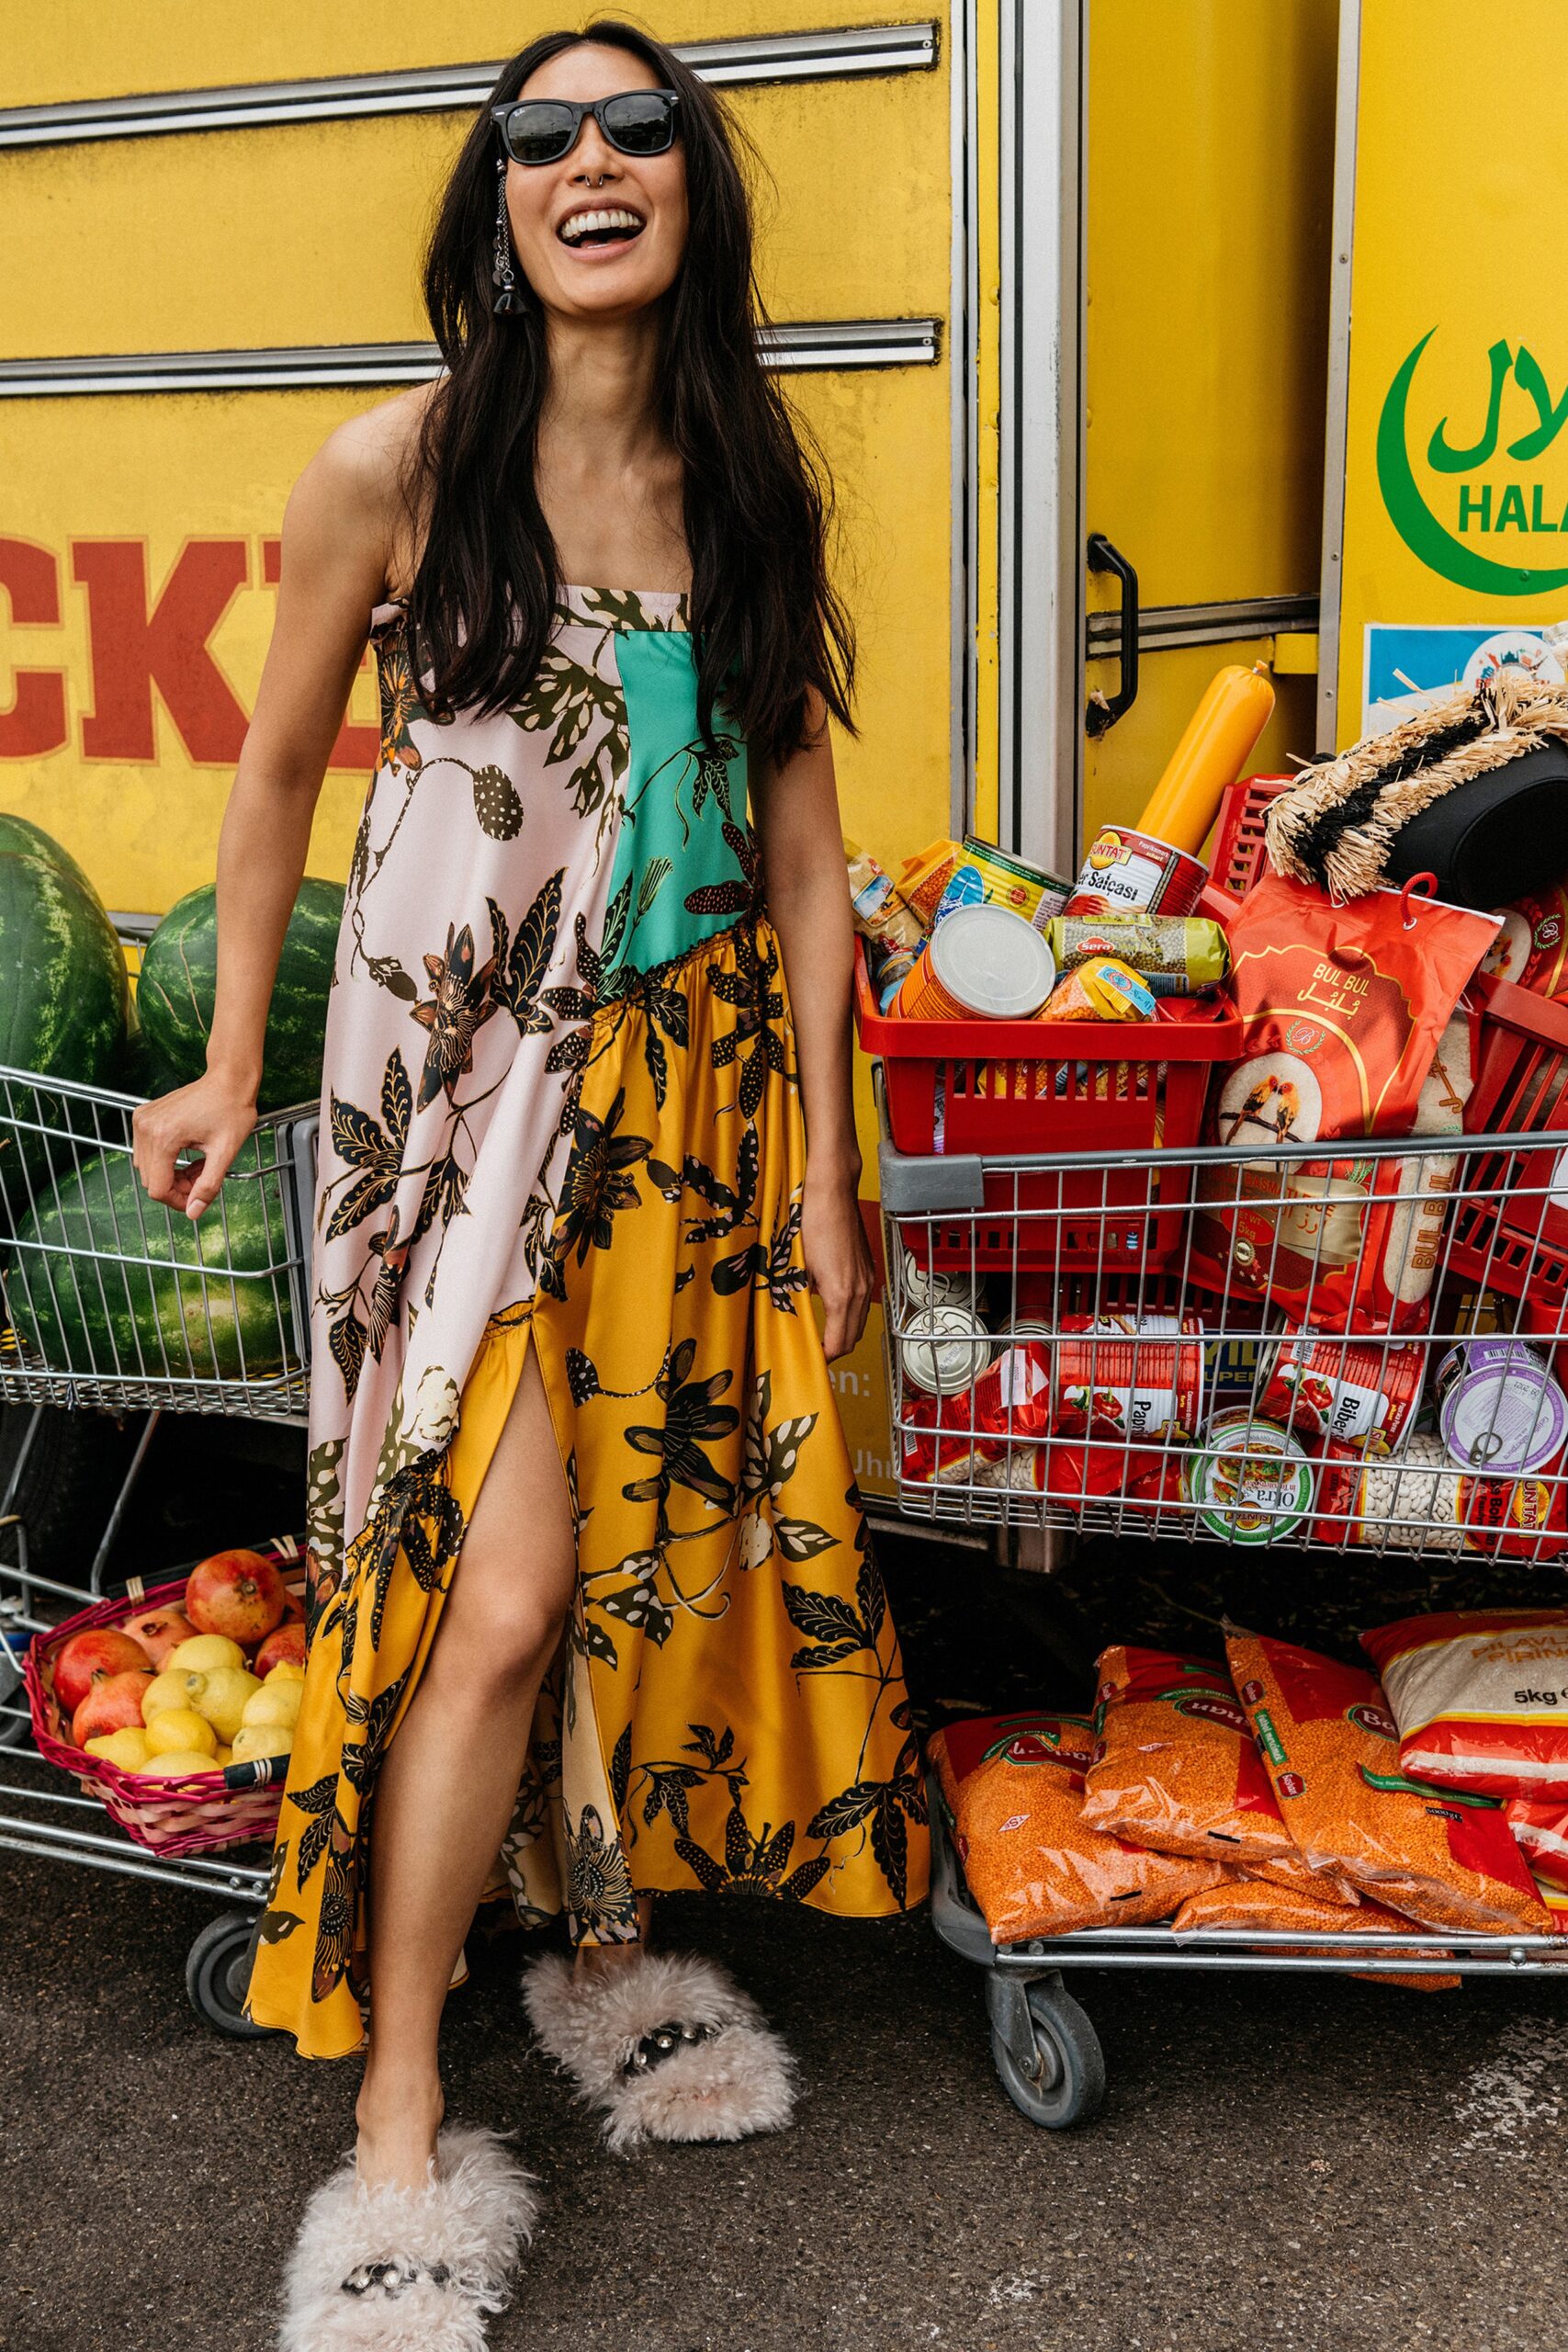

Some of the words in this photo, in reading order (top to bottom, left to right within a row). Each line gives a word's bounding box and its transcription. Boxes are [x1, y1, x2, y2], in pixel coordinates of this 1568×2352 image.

[1458, 485, 1568, 533] HAL
[1089, 871, 1139, 901] Salçası
[1081, 941, 1111, 952] Sera
[1313, 963, 1342, 987] BUL
[1343, 975, 1370, 997] BUL
[1245, 1171, 1299, 1200] BASMTI
[1237, 1221, 1256, 1241] 5kg
[1411, 1222, 1443, 1270] BUL
[1132, 1401, 1152, 1437] Papri
[1333, 1396, 1360, 1438] Biber
[1521, 1479, 1539, 1530] UNTA
[1484, 1498, 1504, 1547] Bohen
[1472, 1635, 1568, 1659] PILAVL
[1514, 1689, 1558, 1706] 5kg
[1191, 1701, 1249, 1728] han
